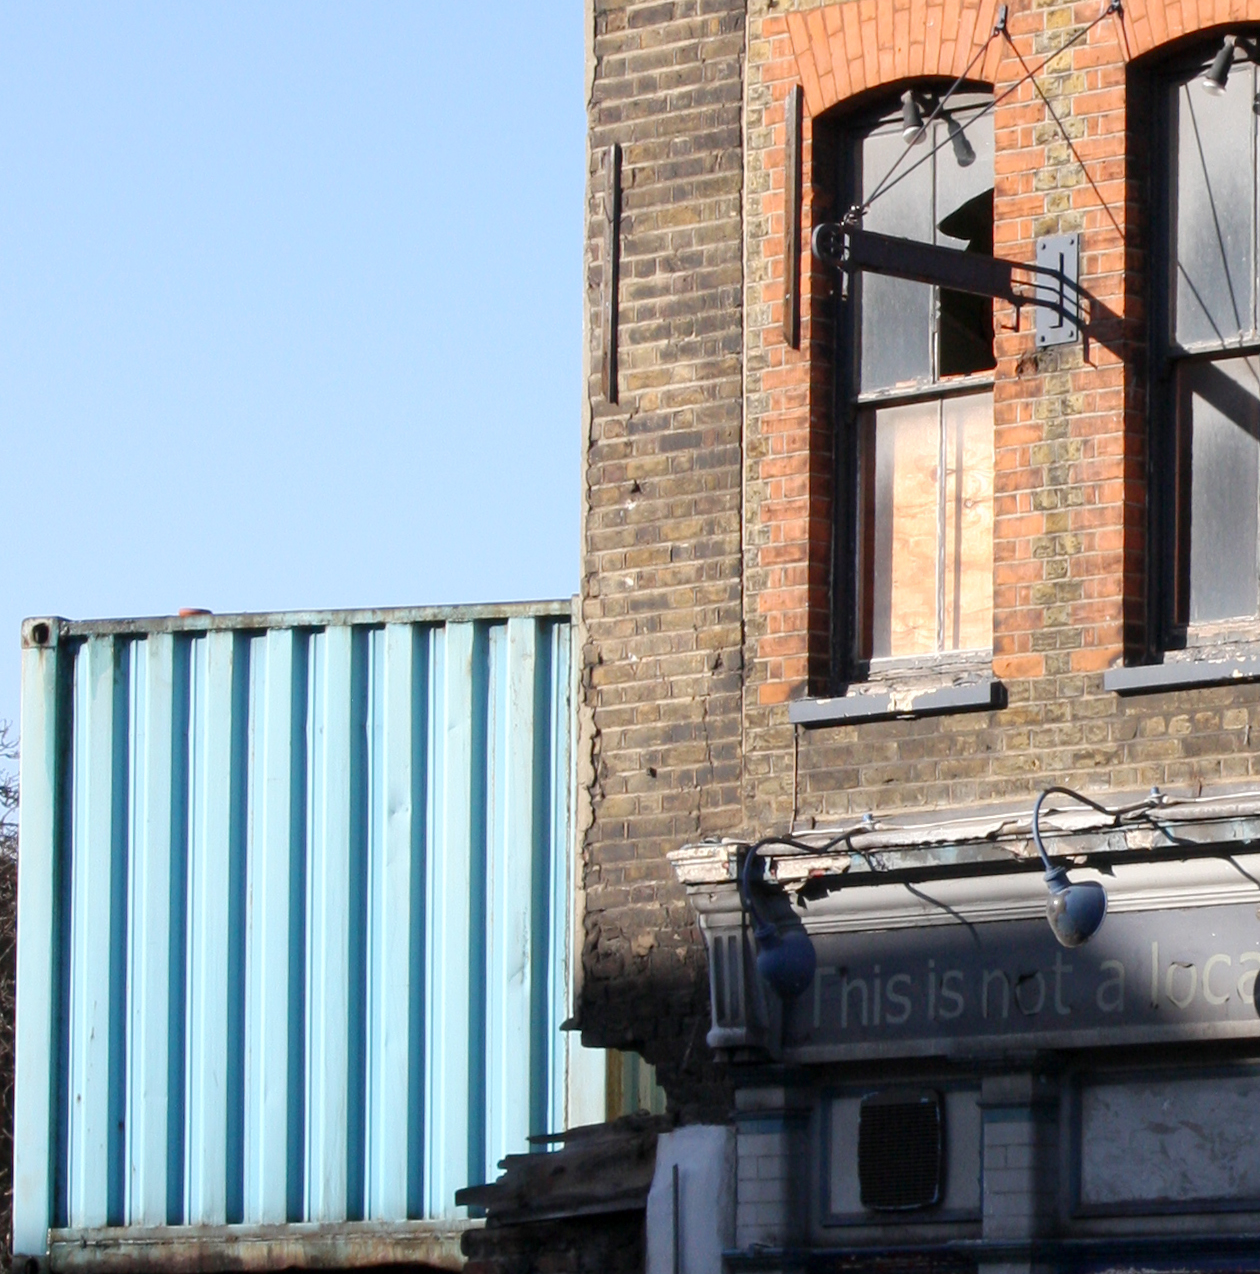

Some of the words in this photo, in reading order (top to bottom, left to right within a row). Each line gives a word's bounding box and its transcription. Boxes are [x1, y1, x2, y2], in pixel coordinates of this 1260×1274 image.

[927, 959, 965, 1020] is
[982, 951, 1074, 1018] not
[1095, 958, 1126, 1013] a
